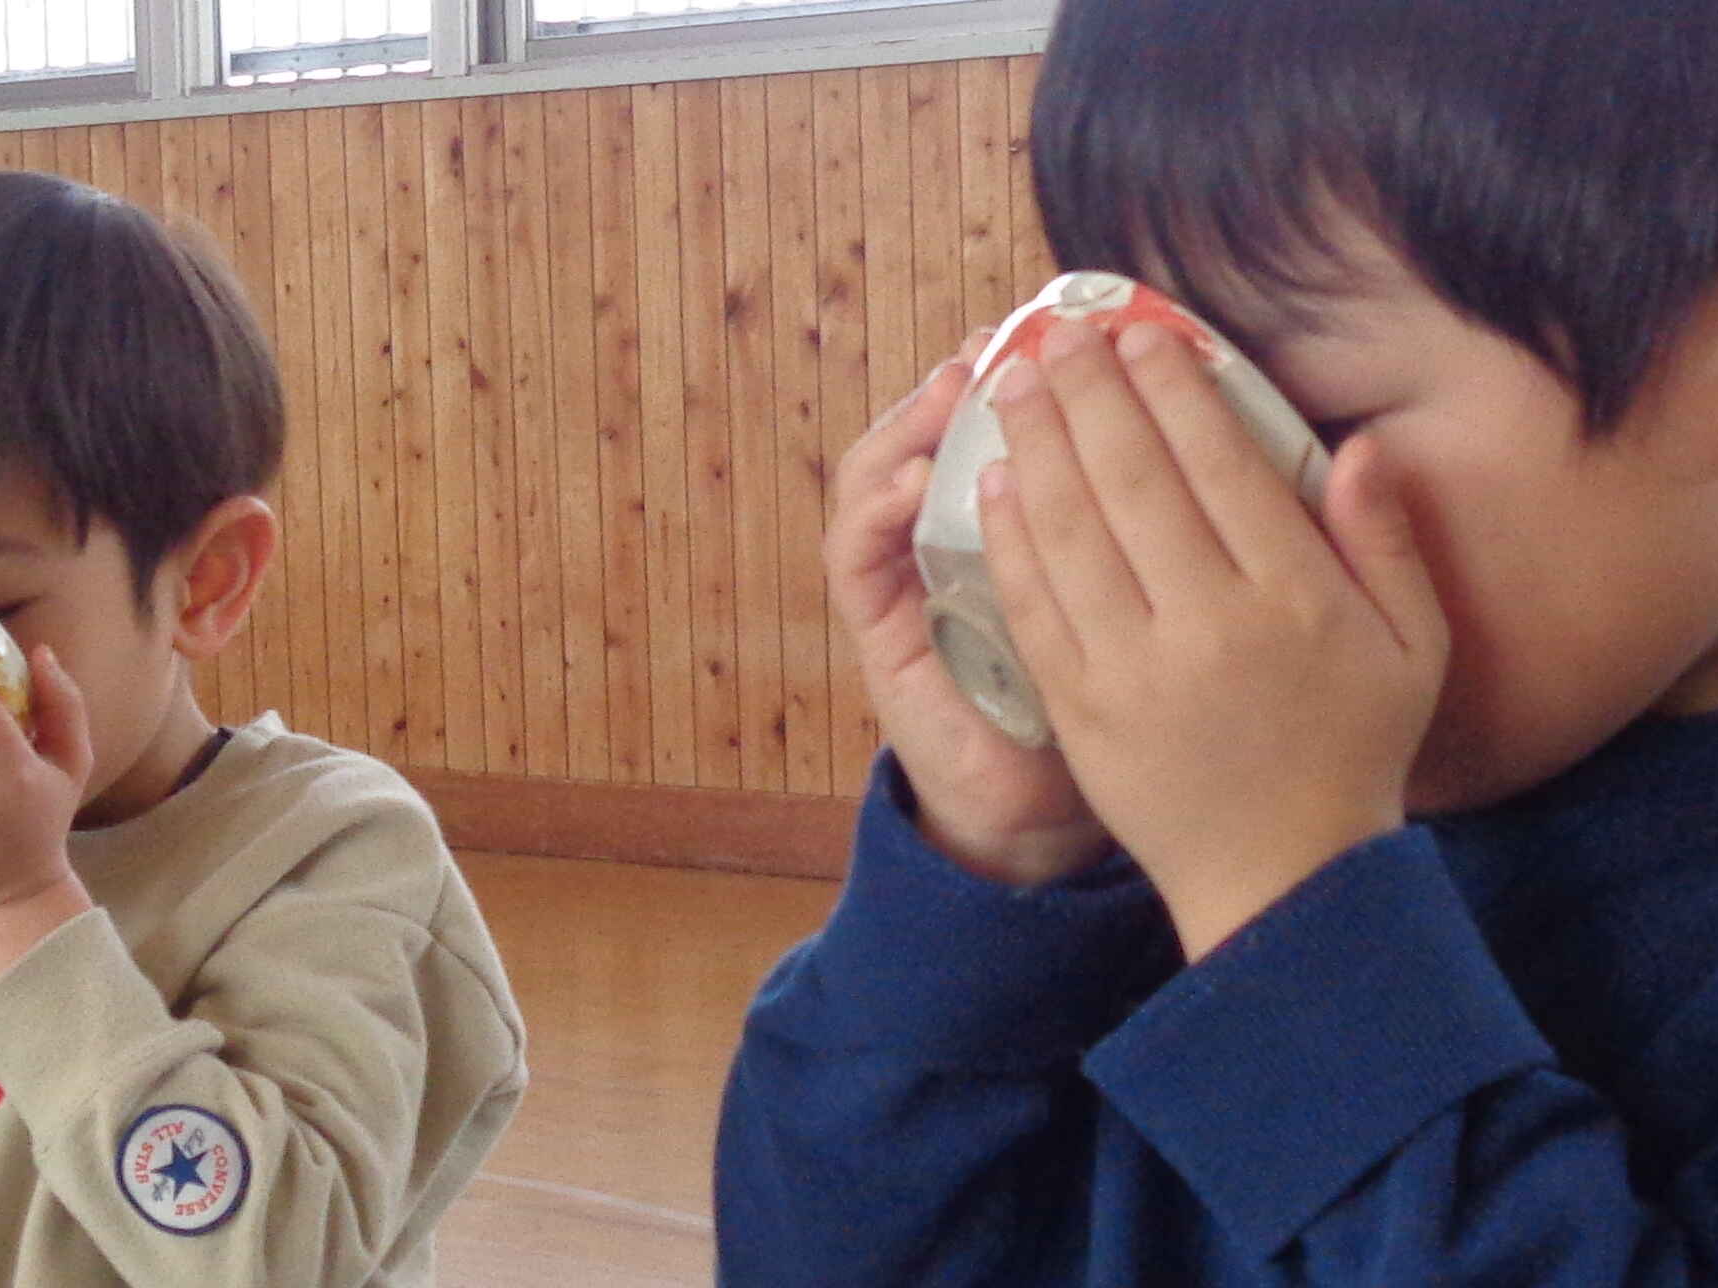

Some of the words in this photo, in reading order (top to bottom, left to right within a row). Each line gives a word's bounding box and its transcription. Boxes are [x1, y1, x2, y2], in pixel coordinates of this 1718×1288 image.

[150, 1121, 185, 1141] ALL
[134, 1142, 155, 1184] STAR
[174, 1143, 229, 1216] CONVERSE
